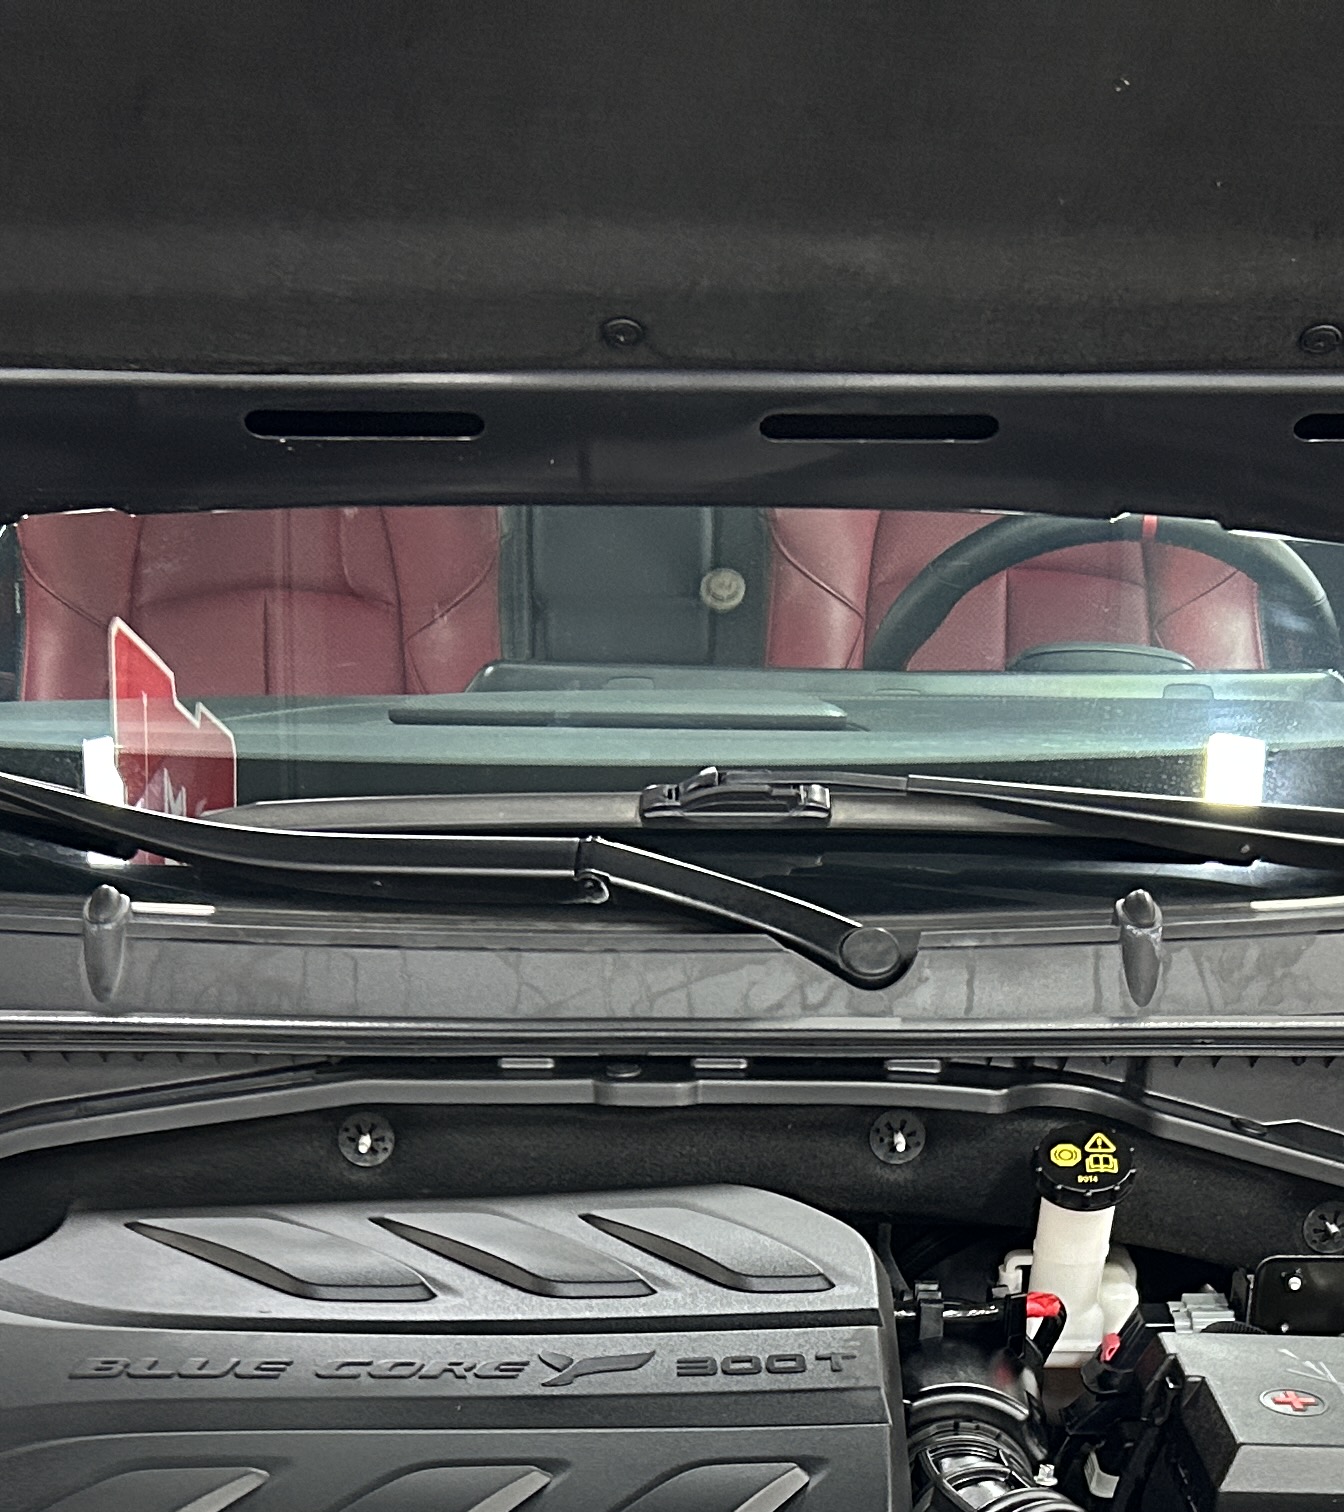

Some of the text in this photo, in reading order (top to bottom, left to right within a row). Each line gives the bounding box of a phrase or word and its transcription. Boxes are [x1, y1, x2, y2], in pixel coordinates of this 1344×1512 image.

[68, 1351, 857, 1380] BLUE CORE 300T
